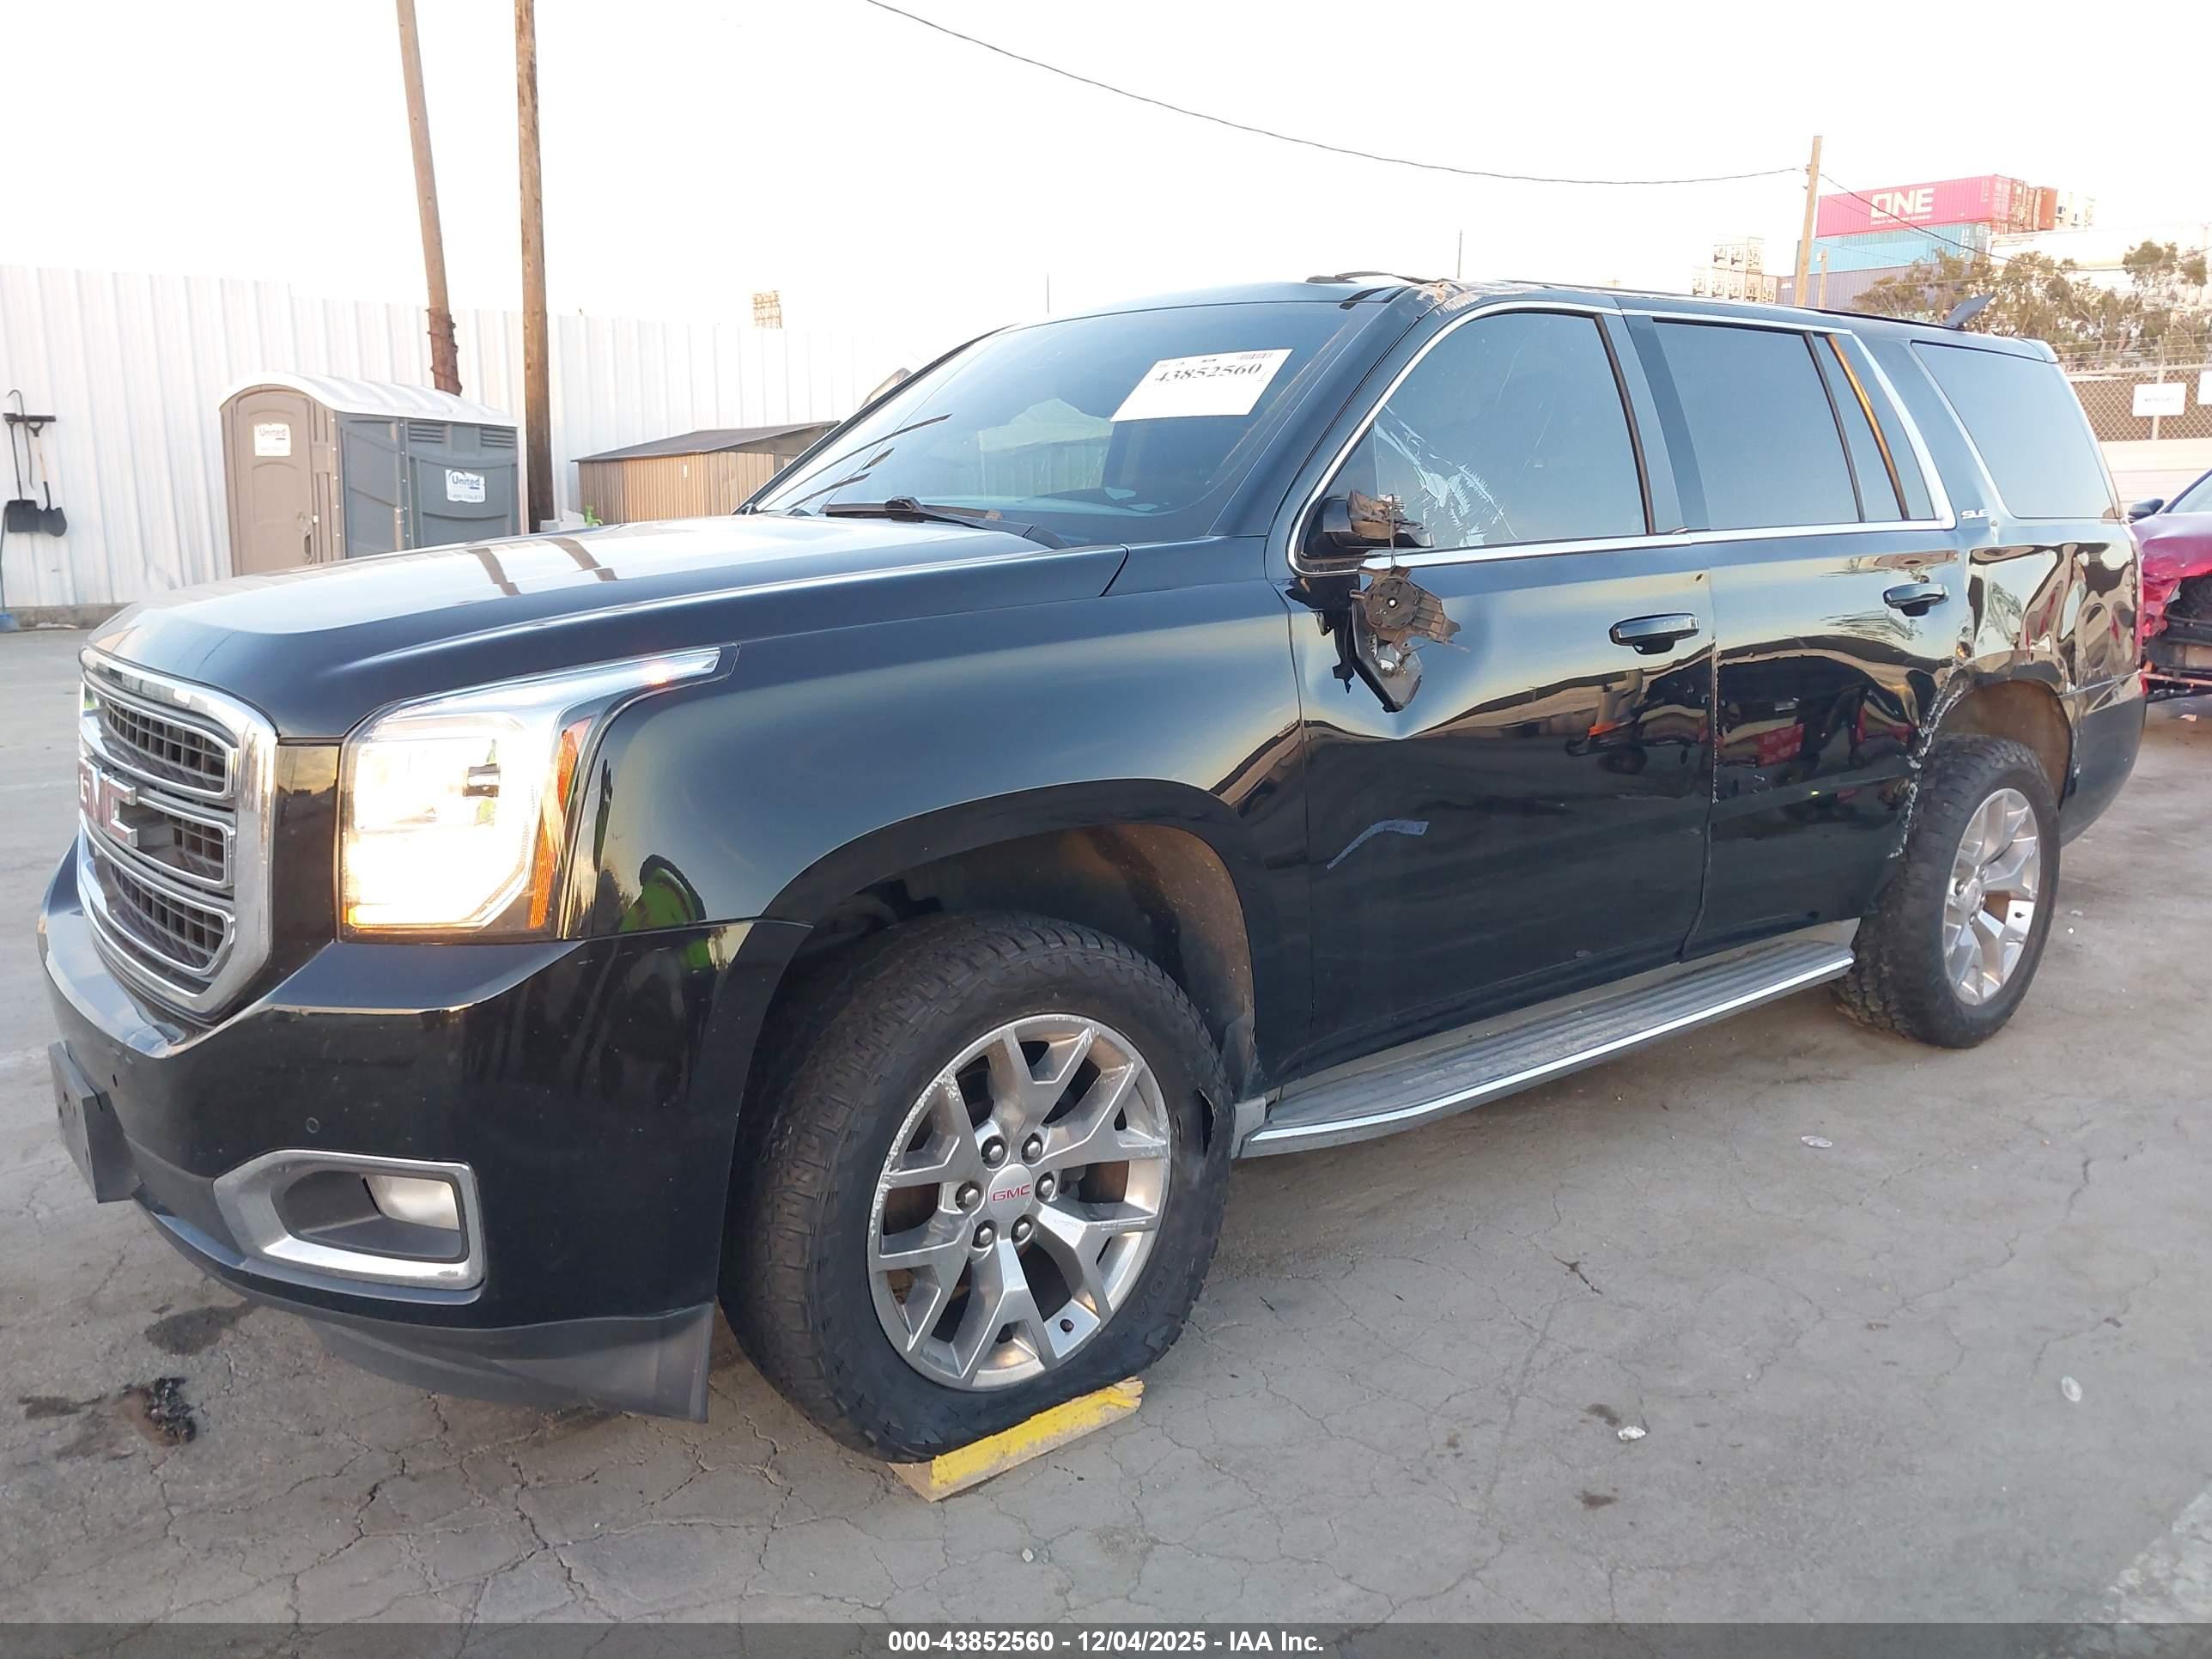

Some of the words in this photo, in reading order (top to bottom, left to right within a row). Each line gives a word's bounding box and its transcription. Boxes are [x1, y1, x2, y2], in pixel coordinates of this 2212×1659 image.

[1870, 187, 1935, 218] ONE
[1154, 362, 1262, 383] 43852560
[452, 475, 480, 487] United
[993, 1184, 1031, 1201] GMC
